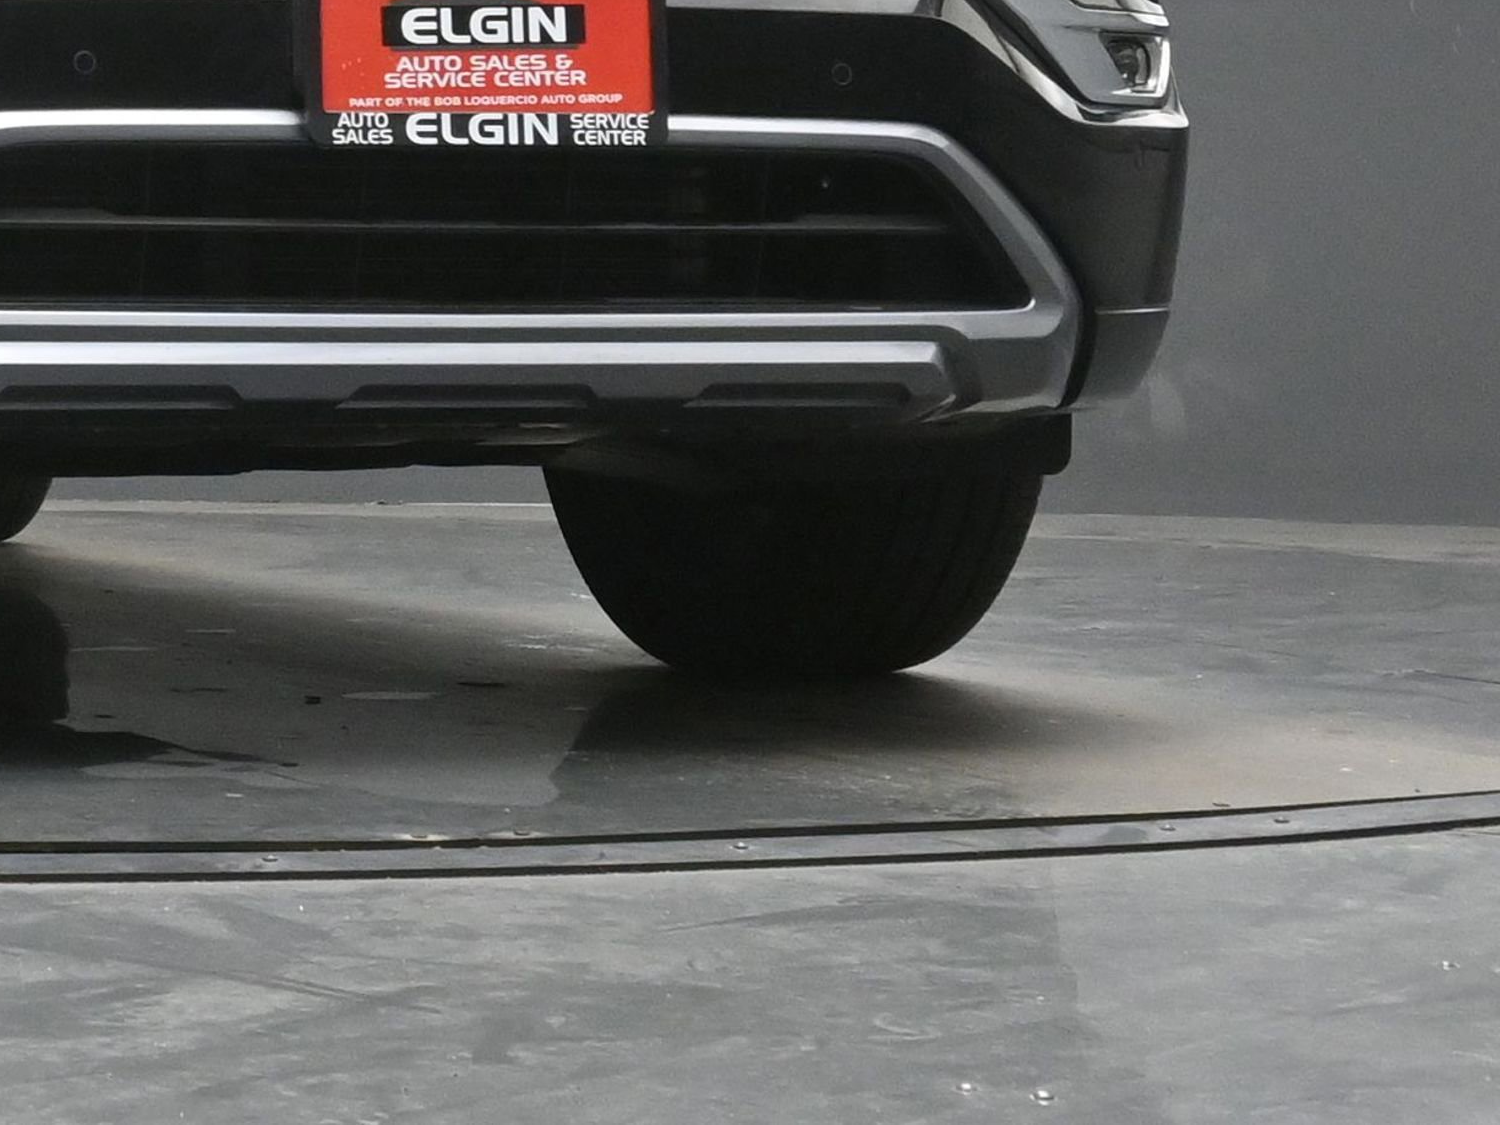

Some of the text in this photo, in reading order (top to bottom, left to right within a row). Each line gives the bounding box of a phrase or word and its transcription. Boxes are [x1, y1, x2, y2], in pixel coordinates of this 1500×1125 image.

[401, 6, 567, 44] ELGIN
[396, 54, 574, 72] AUTO SALES &
[384, 70, 587, 89] SERVICE CENTER
[349, 93, 623, 108] PART OF THE BOB LOQUERCIO AUTO GROUP
[337, 112, 389, 128] AUTO
[570, 113, 649, 129] SERVICE
[332, 129, 393, 145] SALES
[405, 113, 558, 145] ELGIN
[573, 130, 646, 146] CENTER
